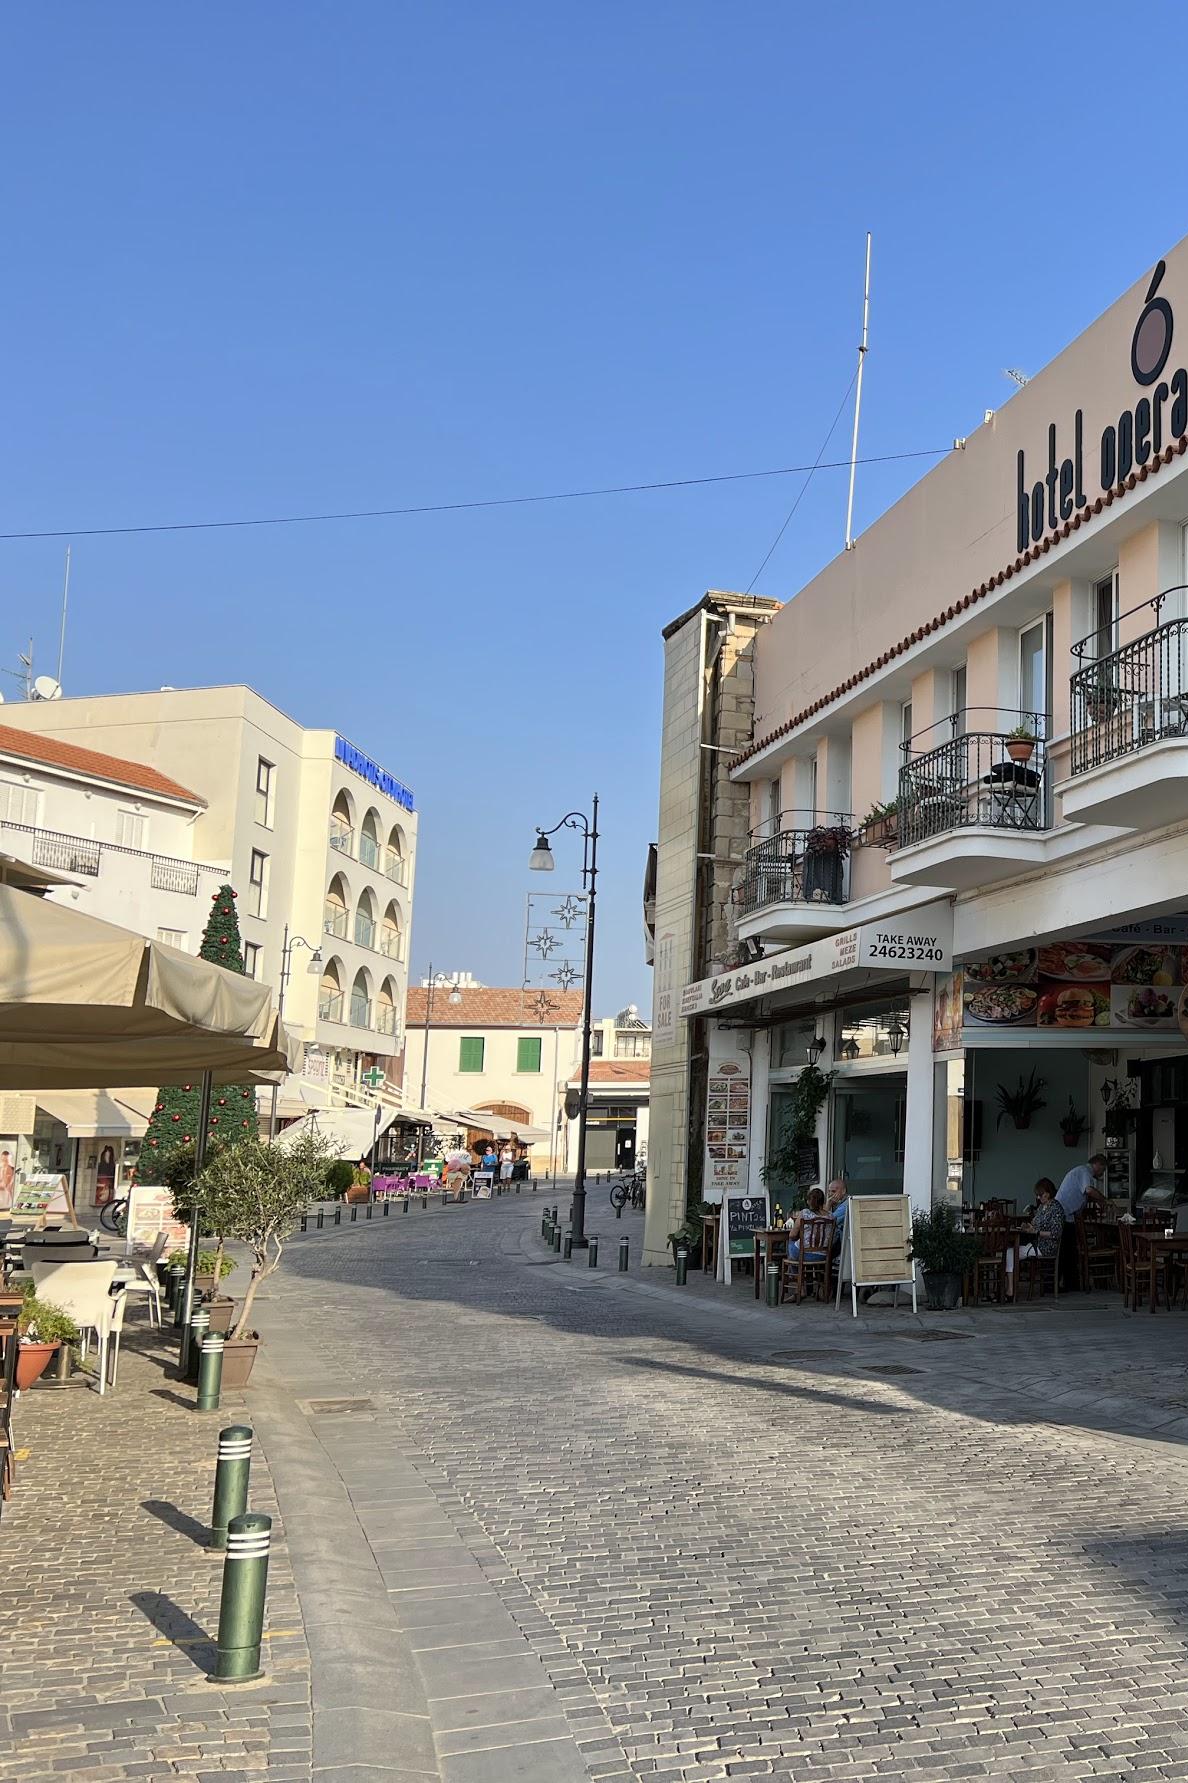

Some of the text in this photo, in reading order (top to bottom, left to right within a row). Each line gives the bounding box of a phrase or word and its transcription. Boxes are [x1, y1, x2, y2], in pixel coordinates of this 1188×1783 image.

[1017, 368, 1188, 553] hotel opera
[1112, 924, 1140, 934] afé
[1154, 925, 1176, 934] Bar
[876, 933, 937, 947] TAKE AWAY
[869, 944, 943, 962] 24623240
[771, 953, 812, 981] Restaurant
[660, 994, 670, 1010] FOR
[658, 1011, 671, 1028] SALE
